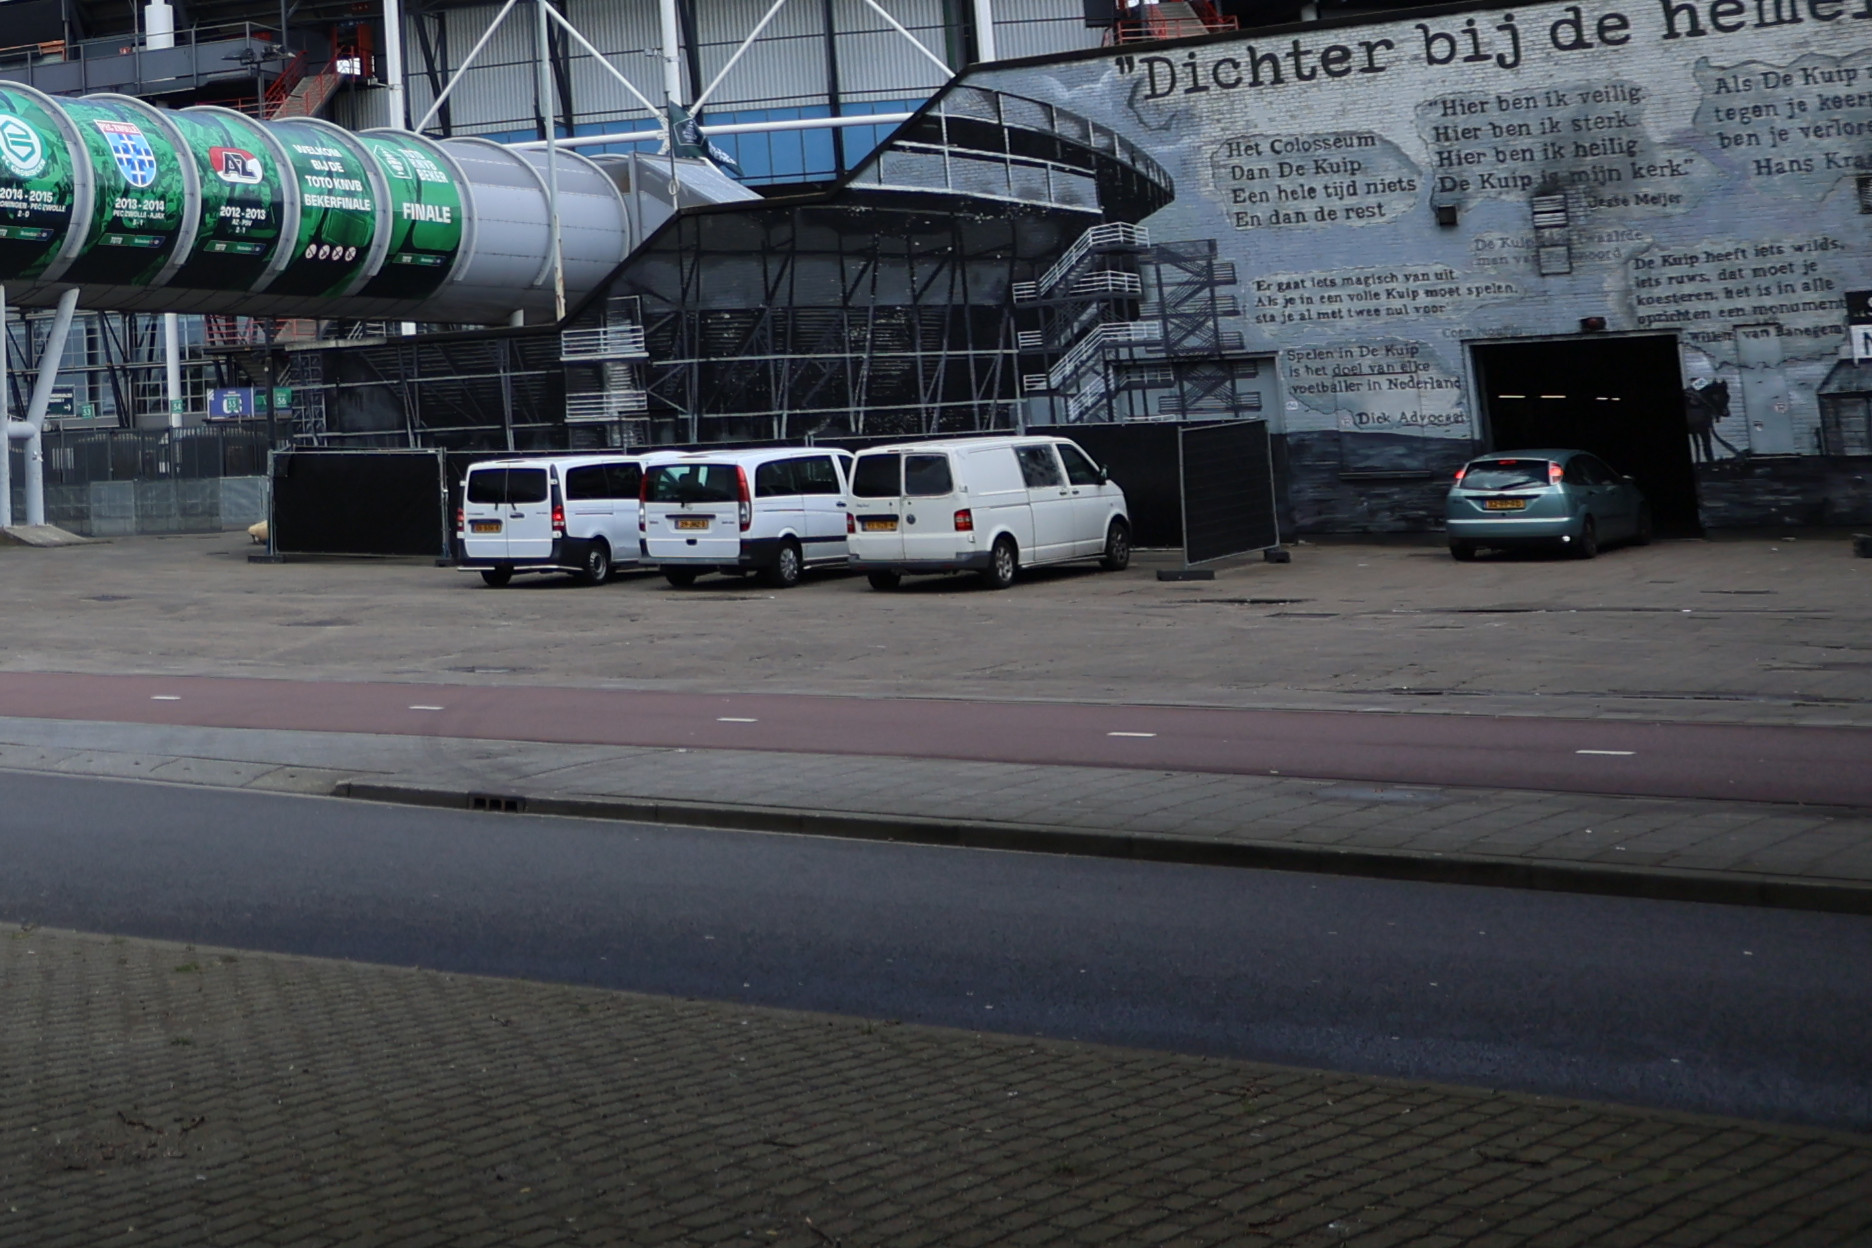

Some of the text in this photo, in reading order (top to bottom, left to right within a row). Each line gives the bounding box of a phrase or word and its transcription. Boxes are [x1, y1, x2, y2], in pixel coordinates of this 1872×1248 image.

[1414, 12, 1522, 69] bij
[1549, 6, 1631, 52] de
[1714, 74, 1753, 94] Als
[1759, 71, 1793, 89] De
[1800, 64, 1858, 87] Kuip
[1497, 96, 1539, 112] ben
[1545, 90, 1568, 107] ik
[1715, 97, 1808, 125] tegen je
[1432, 116, 1561, 143] Hier ben ik
[1717, 126, 1789, 149] ben je
[293, 144, 342, 157] WELKOM
[1227, 134, 1376, 158] Het Colosseum
[1436, 142, 1565, 167] Hier ben ik
[223, 152, 258, 180] AZ
[311, 159, 344, 172] BIJ DE
[1232, 157, 1362, 181] Dan De Kuip
[1752, 157, 1814, 176] Hans
[305, 175, 363, 191] TOTO KNVB
[1438, 165, 1622, 193] De Kuip mijn
[0, 188, 53, 203] 2014 2015
[1232, 177, 1417, 204] Een hele tijd niets
[1634, 192, 1683, 206] Meijer
[115, 197, 165, 211] 2013 2014
[220, 206, 266, 220] 2012 2013
[304, 194, 371, 211] BEKERFINALE
[403, 202, 451, 223] FINALE
[1235, 202, 1386, 227] En dan de rest
[1634, 243, 1785, 270] De Kuip heeft iets
[1276, 271, 1431, 293] gaat iets magisch van
[1635, 259, 1818, 289] iets dat moet je
[1255, 294, 1279, 309] Als
[1283, 294, 1296, 309] je
[1300, 291, 1314, 305] in
[1319, 292, 1343, 304] een
[1348, 289, 1381, 302] volle
[1386, 284, 1420, 301] Kuip
[1424, 285, 1461, 298] moet
[1724, 278, 1836, 299] het is in alle
[1255, 303, 1409, 325] sta je al met twee nul
[1637, 308, 1711, 326] opzichten
[1718, 306, 1746, 317] een
[1742, 327, 1770, 339] van
[1287, 341, 1420, 364] Spelen in De Kuip
[1289, 359, 1430, 378] is het doel van elke
[1291, 376, 1461, 395] voetballer in Nederland
[1358, 411, 1391, 426] Dick
